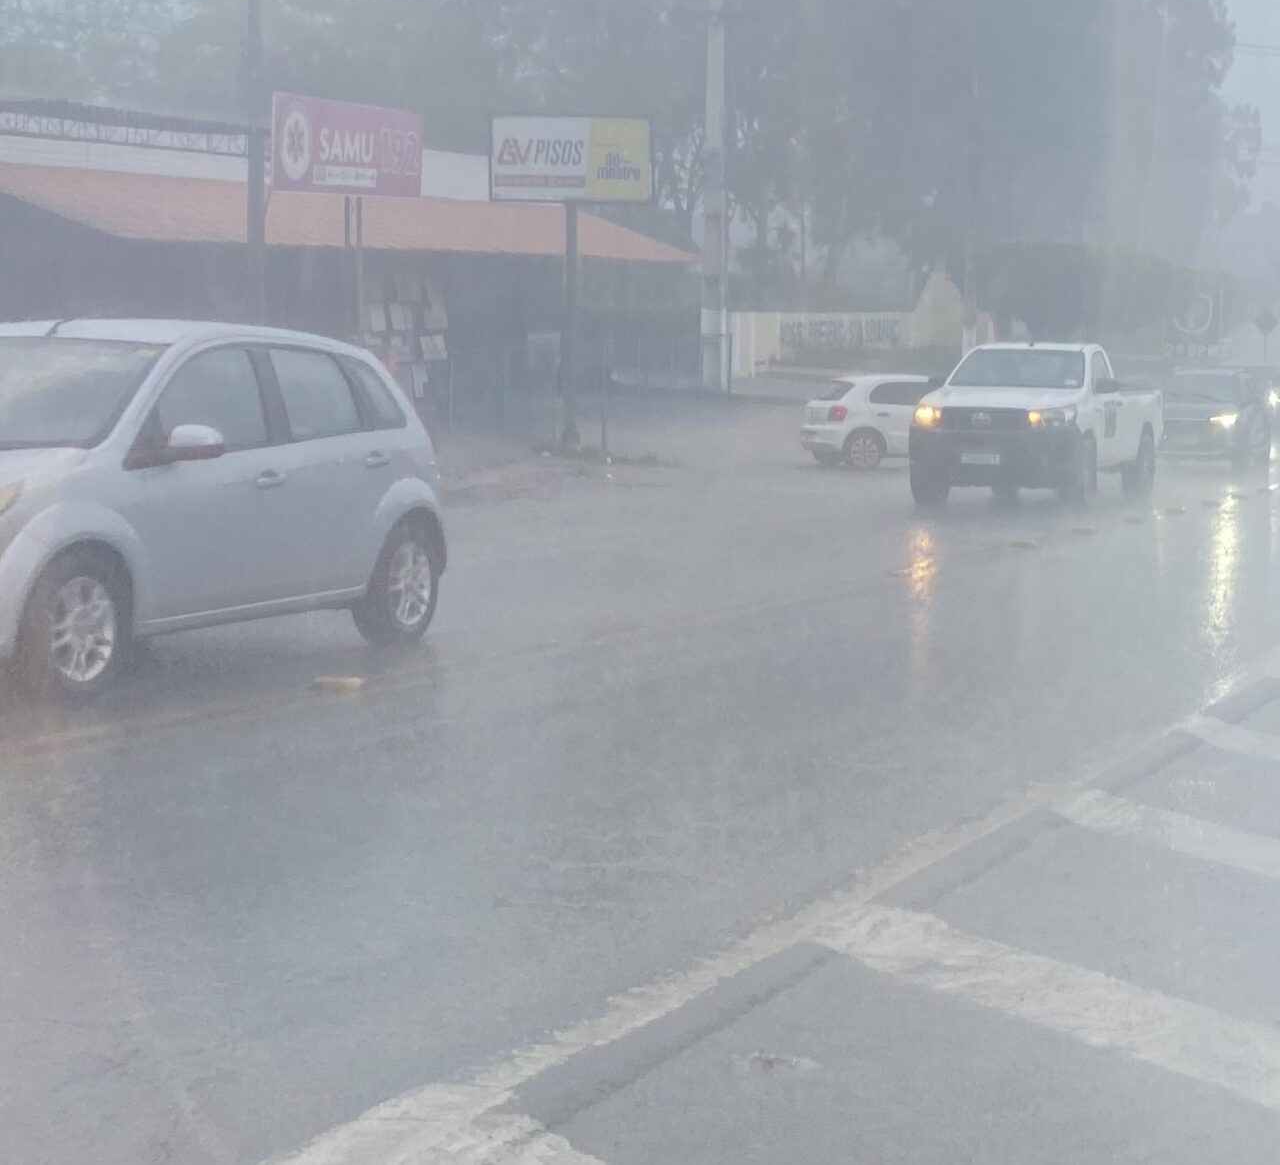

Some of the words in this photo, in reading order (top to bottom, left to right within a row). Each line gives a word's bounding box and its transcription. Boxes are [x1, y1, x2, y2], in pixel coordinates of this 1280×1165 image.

[319, 127, 374, 163] SAMU
[380, 127, 420, 176] 192
[534, 138, 584, 166] PISOS
